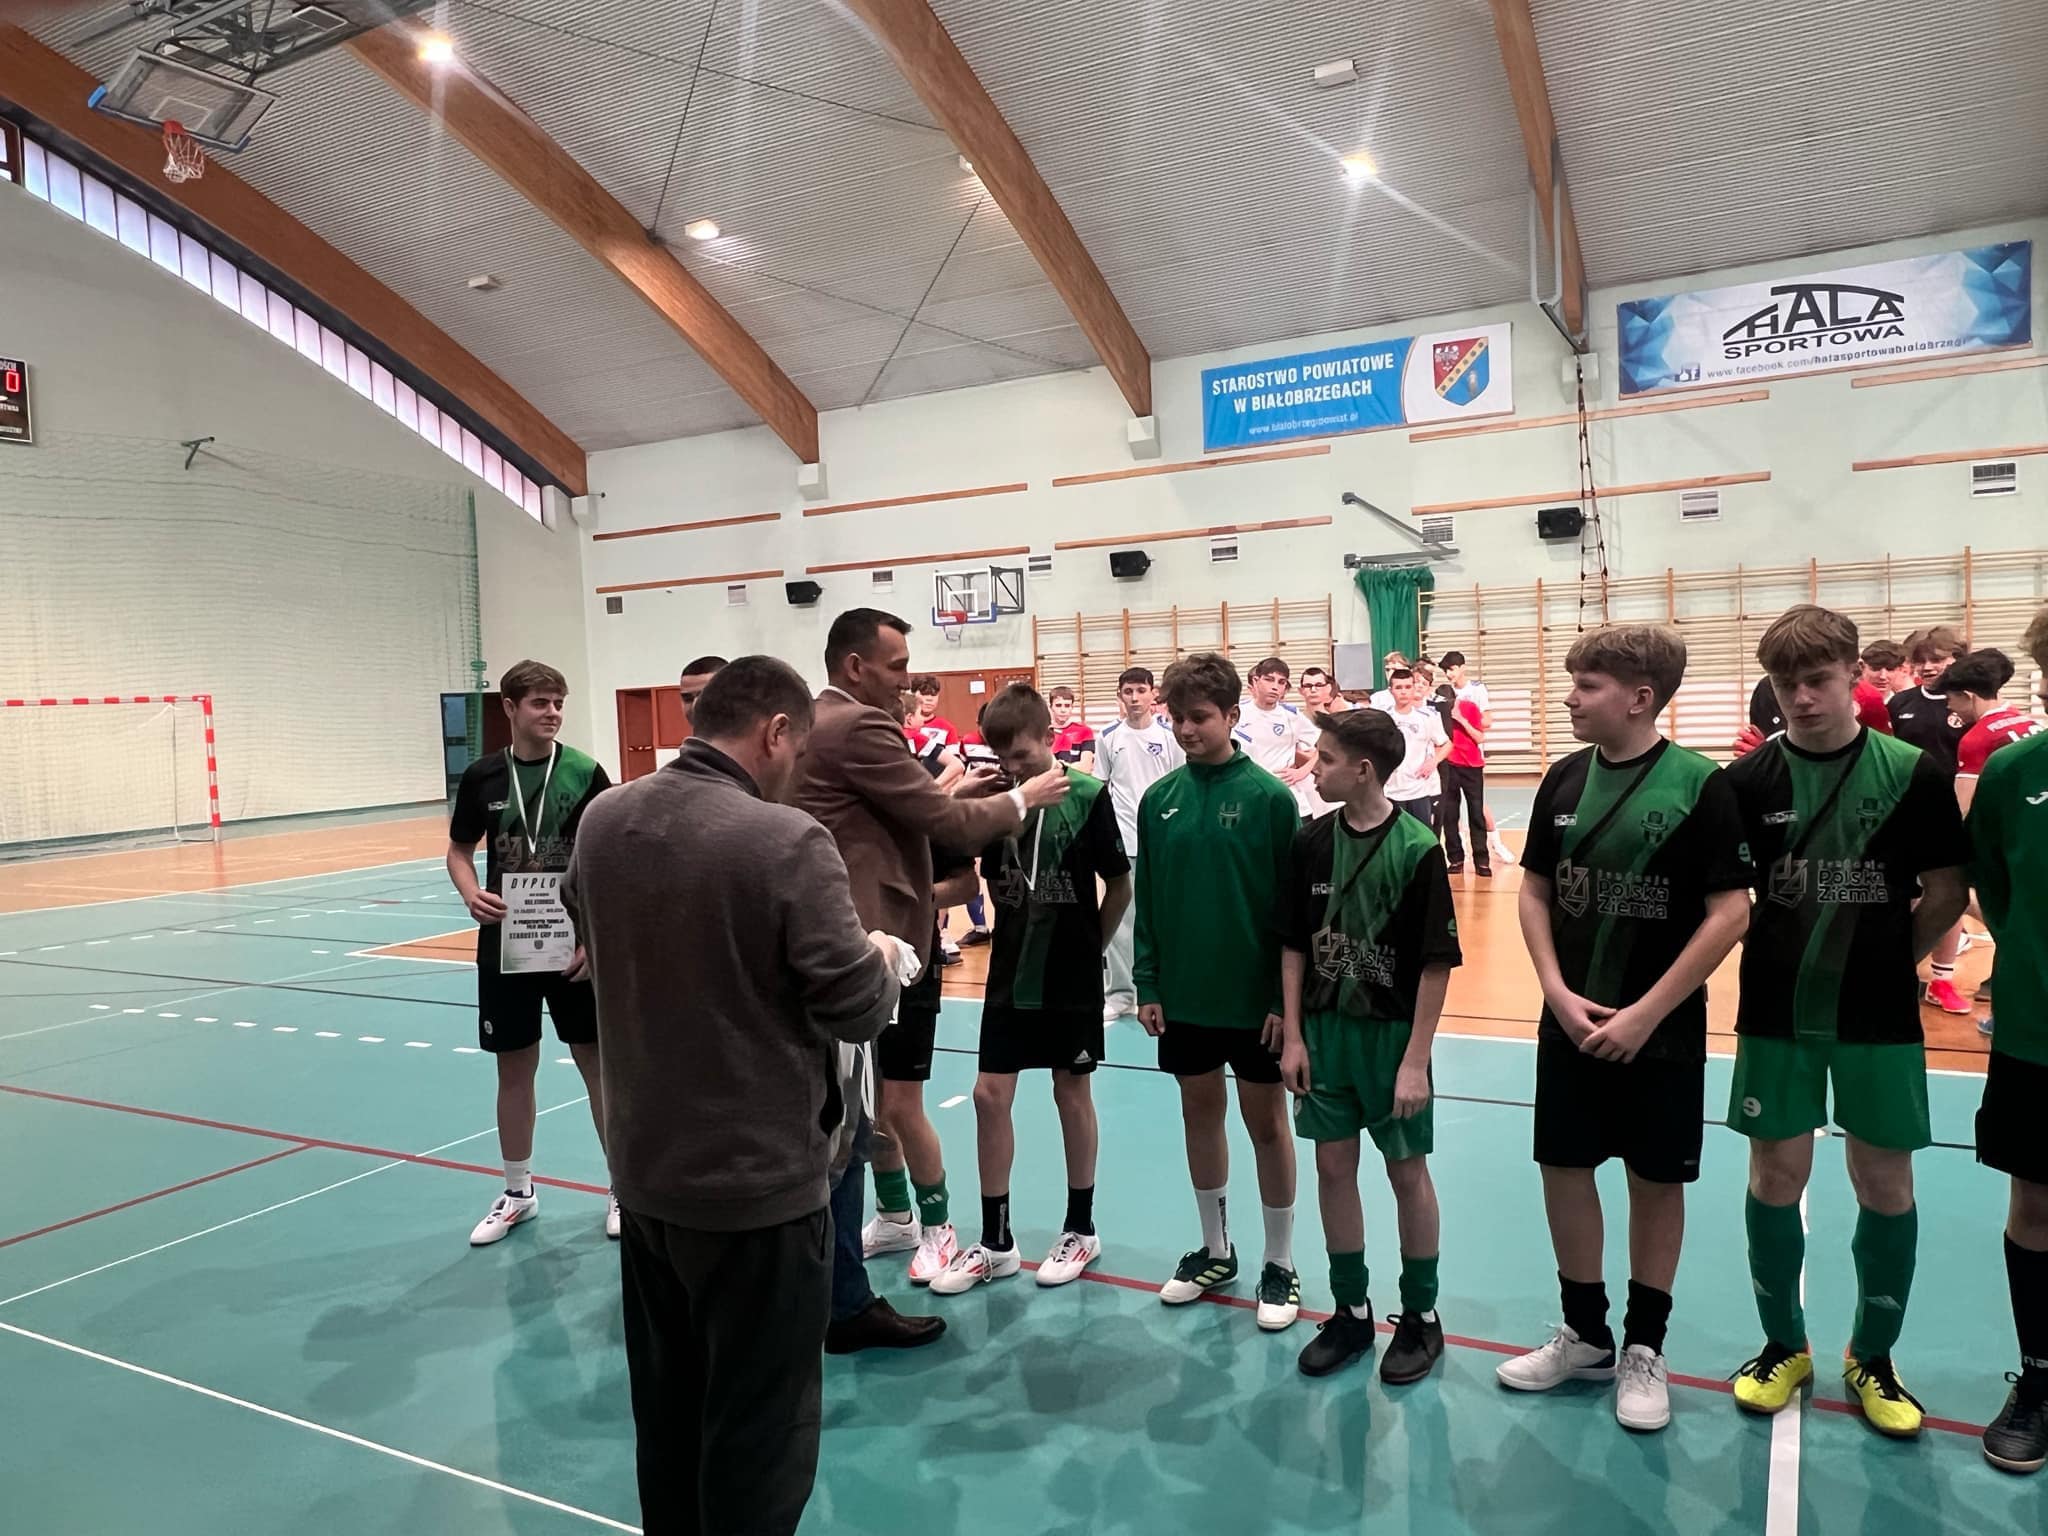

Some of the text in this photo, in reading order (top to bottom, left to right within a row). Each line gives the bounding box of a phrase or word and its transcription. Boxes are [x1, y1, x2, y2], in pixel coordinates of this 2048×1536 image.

[1723, 283, 1904, 336] HALA
[1724, 325, 1904, 359] SPORTOWA
[1212, 352, 1394, 396] STAROSTWO POWIATOWE
[1233, 379, 1372, 414] W BIAŁOBRZEGACH
[511, 877, 557, 889] DYPLO
[1817, 869, 1886, 887] Polska
[1598, 879, 1669, 902] Polska
[1817, 885, 1888, 903] Ziemia
[1597, 895, 1668, 919] Ziemia
